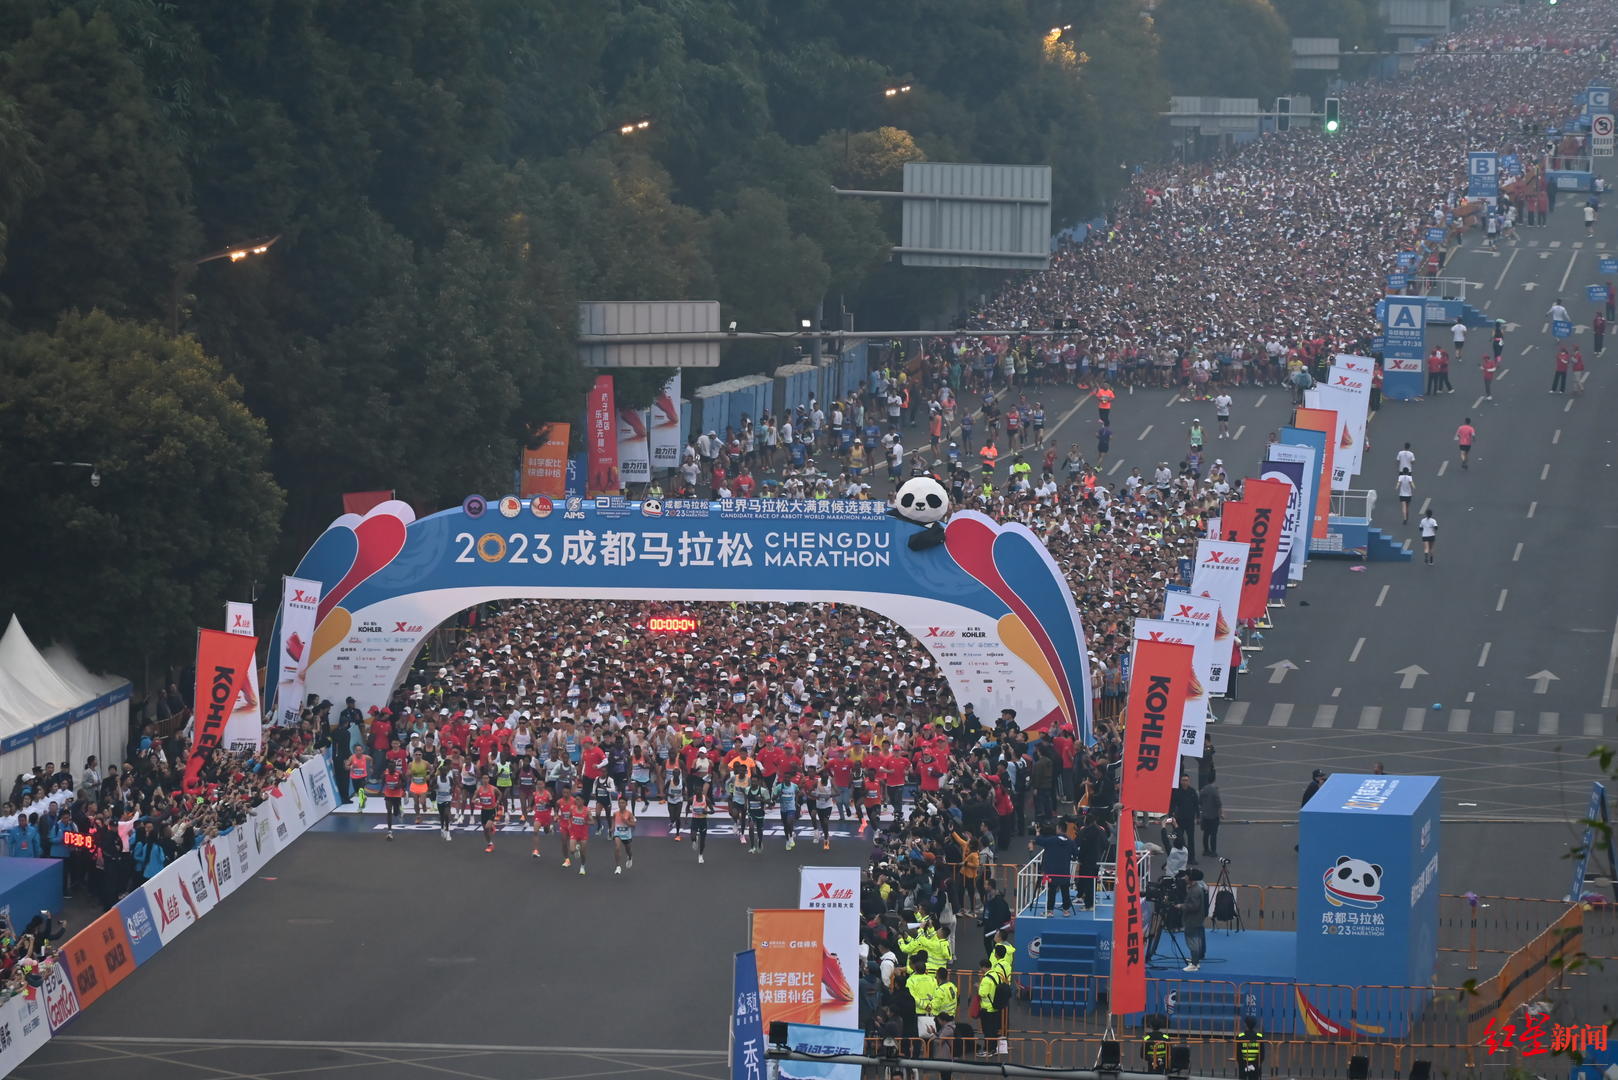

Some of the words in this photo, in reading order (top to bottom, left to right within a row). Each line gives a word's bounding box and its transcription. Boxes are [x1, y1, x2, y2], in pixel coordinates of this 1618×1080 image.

[1476, 160, 1490, 174] B
[1393, 306, 1416, 328] A
[664, 509, 686, 517] 2023
[665, 500, 709, 510] 成都马拉松
[720, 499, 886, 515] 世界马拉松大满贯候选赛事
[563, 511, 585, 519] AIMS
[455, 532, 553, 564] 2023
[560, 529, 753, 568] 成都马拉松
[765, 532, 890, 549] CHENGDU
[1244, 507, 1272, 586] KOHLER
[765, 551, 890, 568] MARATHON
[650, 618, 695, 631] 00:00:04
[1136, 675, 1172, 773] KOHLER
[1124, 849, 1140, 967] KOHLER
[1321, 911, 1385, 926] 成都马拉松
[1322, 925, 1352, 936] 2023
[759, 971, 815, 987] 科学配比
[759, 989, 815, 1004] 快速补给
